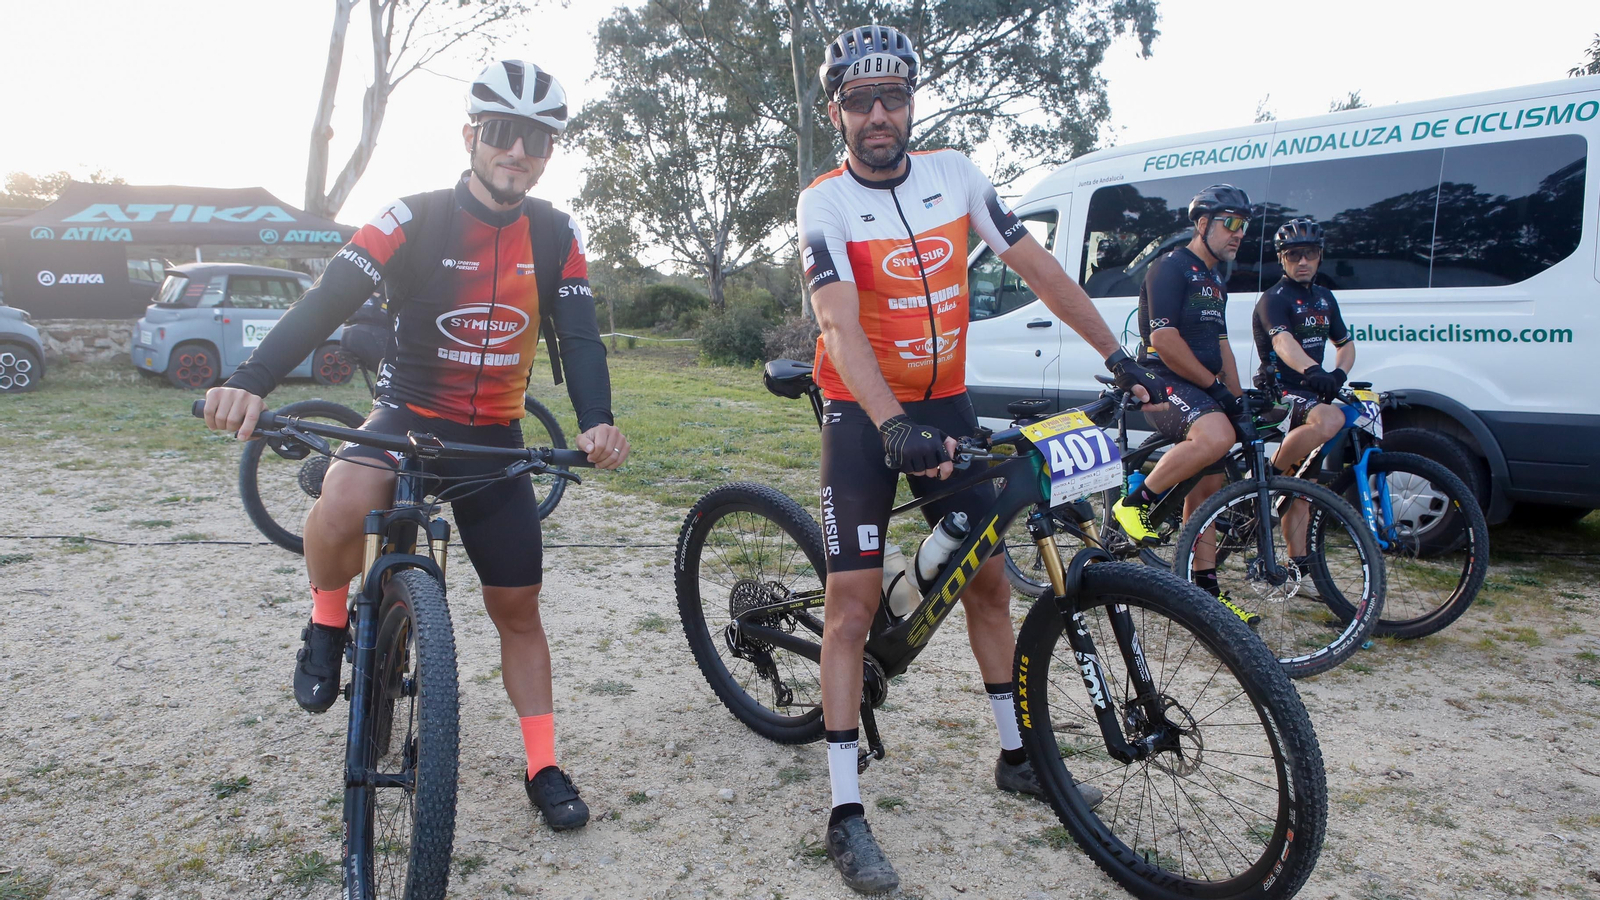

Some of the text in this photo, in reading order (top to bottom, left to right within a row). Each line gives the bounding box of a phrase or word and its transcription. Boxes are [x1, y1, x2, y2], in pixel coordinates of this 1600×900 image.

[853, 57, 901, 76] GOBIK
[1143, 100, 1600, 172] FEDERACIÓN ANDALUZA DE CICLISMO
[61, 203, 297, 223] ATIKA
[61, 227, 133, 241] ATIKA
[283, 229, 343, 243] ATIKA
[892, 247, 945, 268] SYMISUR
[59, 273, 105, 284] ATIKA
[937, 301, 958, 315] bikes
[450, 317, 518, 332] SYMISUR
[1168, 393, 1190, 412] aero
[1048, 428, 1111, 476] 407
[822, 486, 841, 557] SYMISUR
[1311, 509, 1322, 552] MAXXIS
[680, 525, 693, 571] SCORPION
[907, 514, 999, 648] SCOTT
[1333, 623, 1365, 656] BARZO
[1018, 654, 1032, 729] MAXXIS
[1080, 661, 1106, 709] FOX
[351, 854, 359, 876] DT
